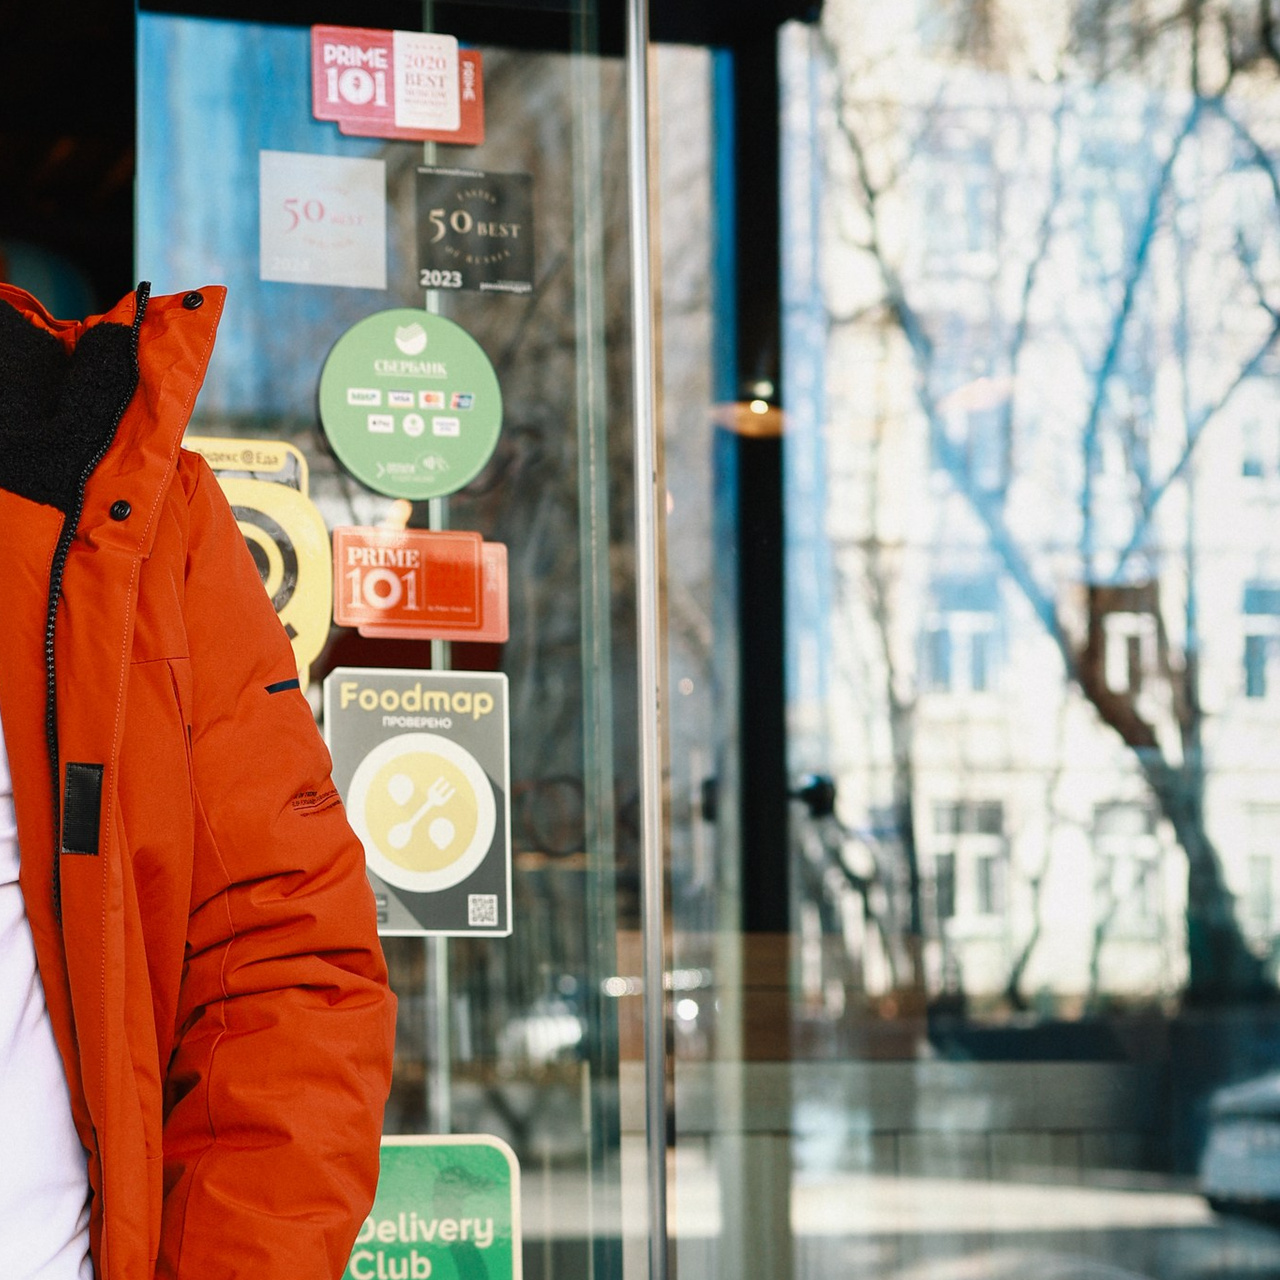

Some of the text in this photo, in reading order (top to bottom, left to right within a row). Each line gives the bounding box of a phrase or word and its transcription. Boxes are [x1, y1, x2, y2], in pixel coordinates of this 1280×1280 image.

[322, 43, 388, 70] PRIME
[404, 53, 447, 71] 2020
[324, 66, 389, 107] 101
[404, 71, 447, 88] BEST
[283, 198, 326, 235] 50
[429, 208, 522, 244] 50 BEST
[420, 268, 463, 288] 2023
[373, 359, 448, 376] СБЕРБАНК
[256, 452, 279, 466] Еда
[346, 545, 421, 569] PRIME
[345, 566, 421, 611] 101
[339, 681, 495, 722] Foodmap
[382, 715, 453, 730] ПРОВЕРЕНО
